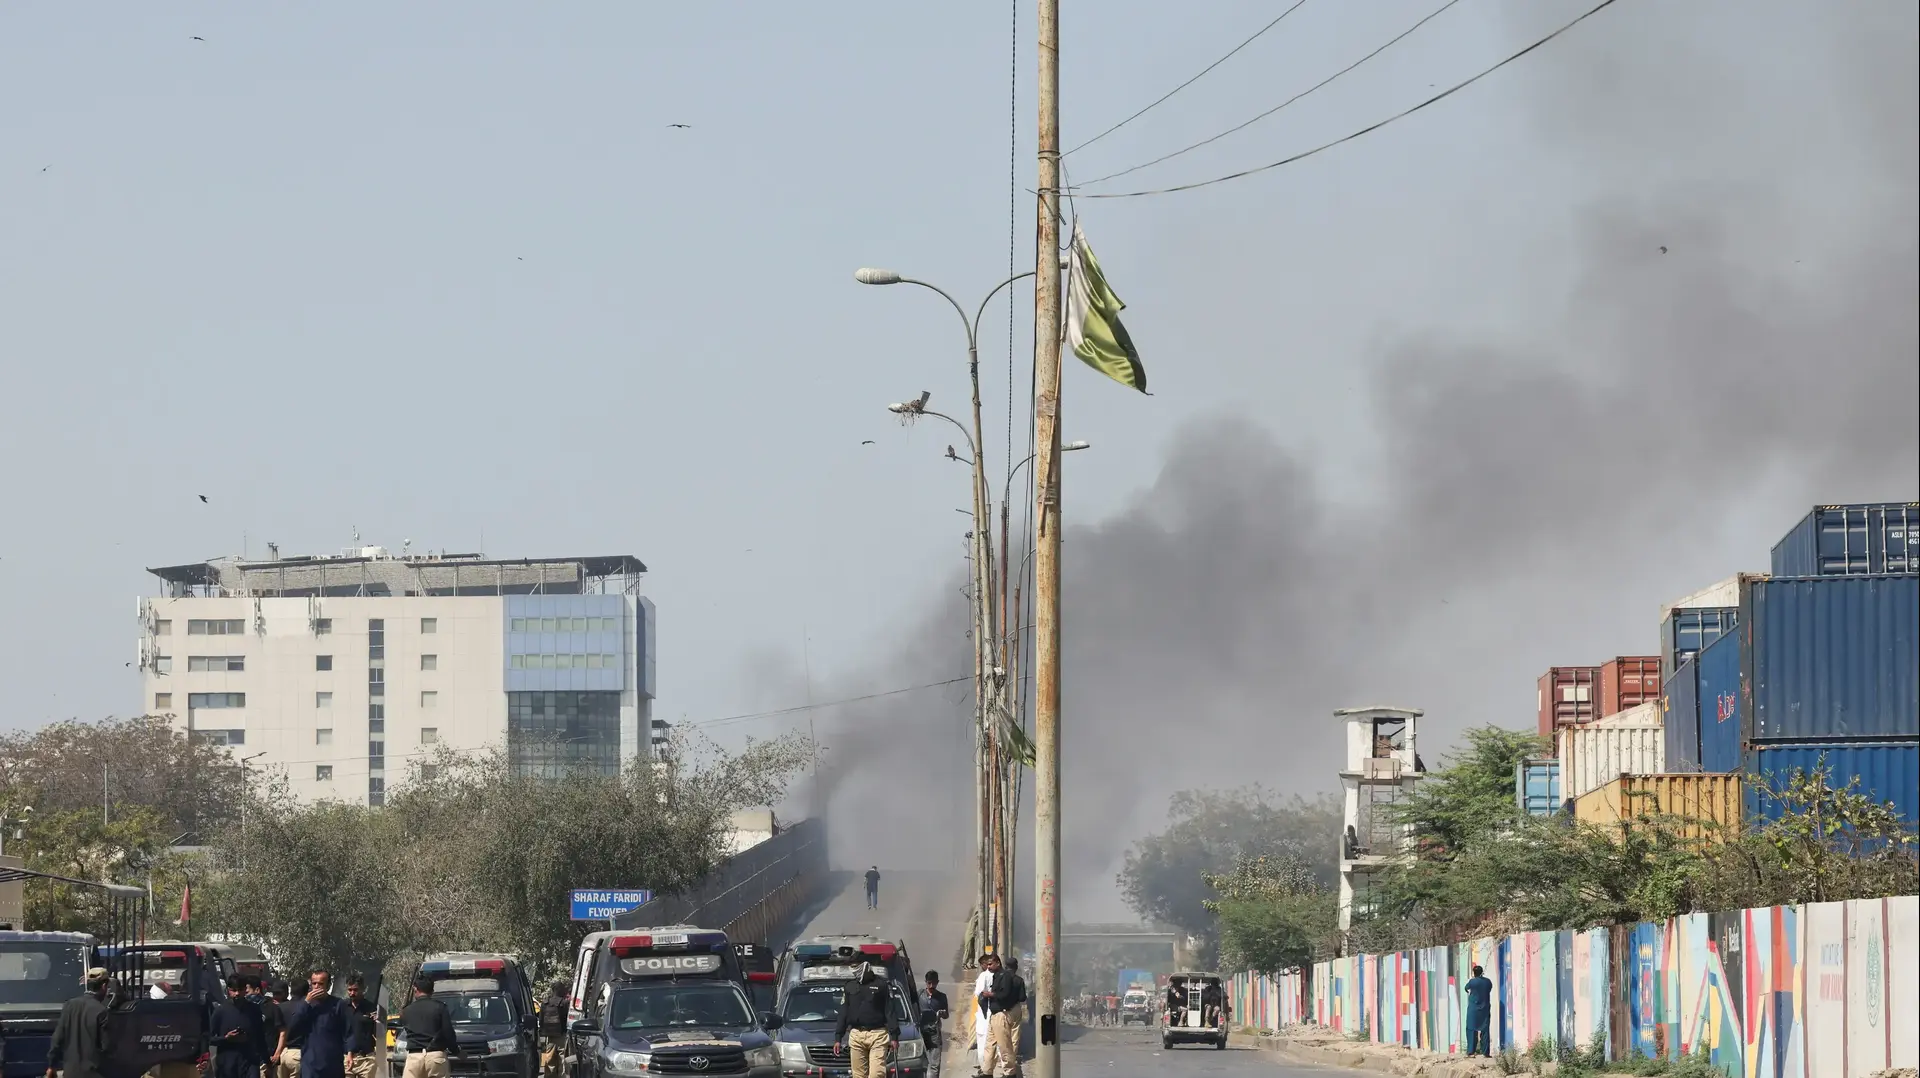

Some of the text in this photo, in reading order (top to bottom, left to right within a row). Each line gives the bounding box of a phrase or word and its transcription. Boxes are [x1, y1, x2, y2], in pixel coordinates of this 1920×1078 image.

[574, 893, 642, 903] SHARAF FARIDI
[634, 957, 709, 970] POLICE
[140, 1035, 182, 1043] MASTER
